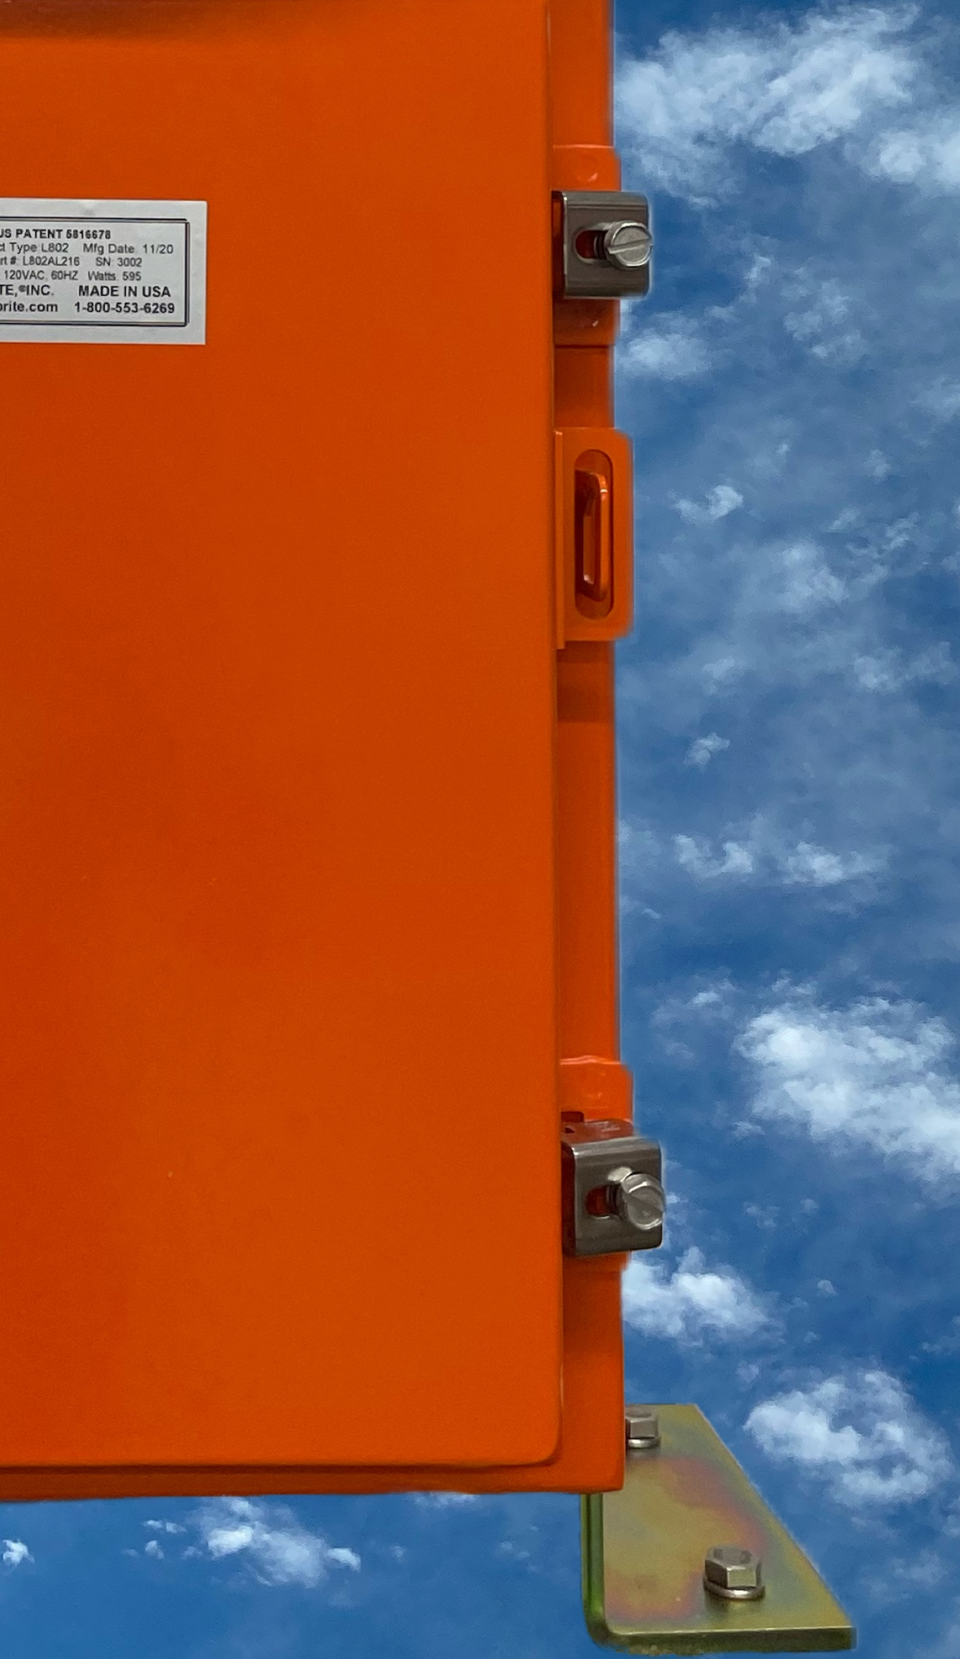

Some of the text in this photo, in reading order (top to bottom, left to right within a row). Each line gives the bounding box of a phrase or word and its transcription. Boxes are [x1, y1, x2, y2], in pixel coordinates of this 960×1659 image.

[16, 228, 63, 239] PATENT
[66, 229, 111, 240] 5816678
[41, 242, 69, 253] L802
[83, 243, 105, 256] Mfg
[143, 243, 174, 254] 11/20
[23, 256, 80, 267] L802AL216
[117, 257, 143, 267] 3002
[51, 270, 79, 281] 60HZ
[122, 271, 142, 281] 595
[78, 285, 119, 297] MADE
[124, 285, 137, 297] IN
[142, 286, 171, 298] USA
[74, 301, 175, 314] 1-800-553-6269
